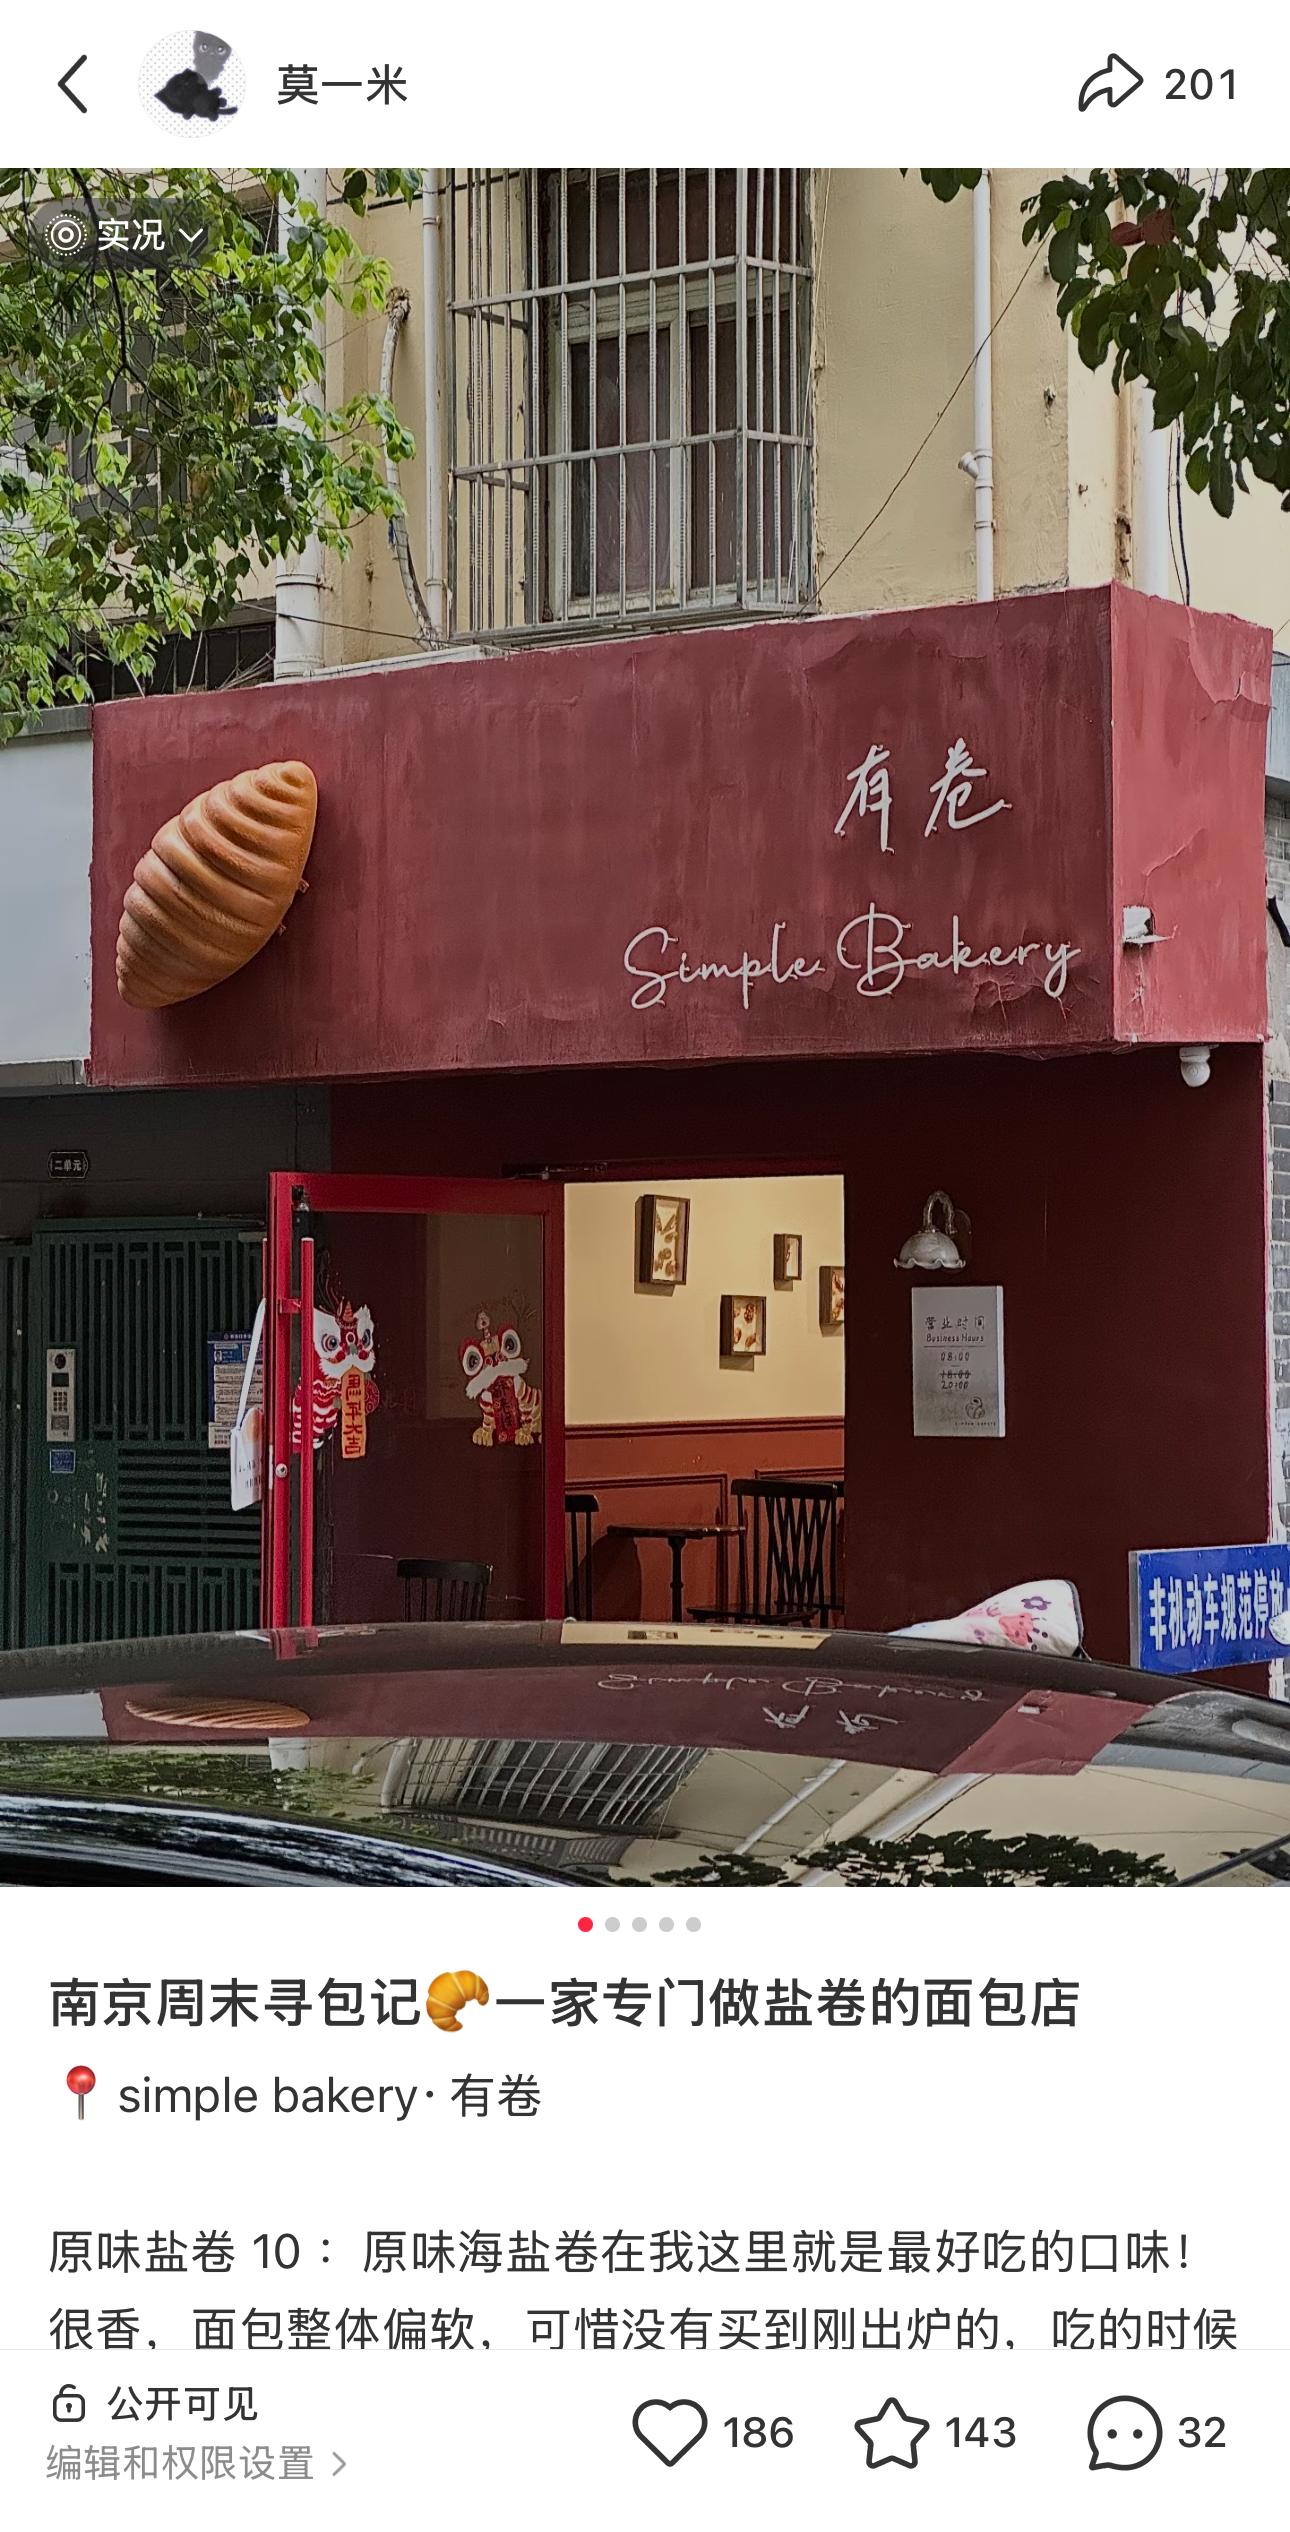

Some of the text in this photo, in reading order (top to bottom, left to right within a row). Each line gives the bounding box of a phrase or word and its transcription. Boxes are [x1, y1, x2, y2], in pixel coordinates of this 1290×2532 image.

[834, 737, 1014, 854] 有卷
[623, 902, 1082, 1010] Simple Bakery
[54, 1158, 82, 1172] 二单元
[924, 1315, 985, 1331] 营业时间
[926, 1332, 985, 1343] Business Hours
[940, 1351, 970, 1361] 08:00
[1148, 1566, 1290, 1652] 非机动车规范停放
